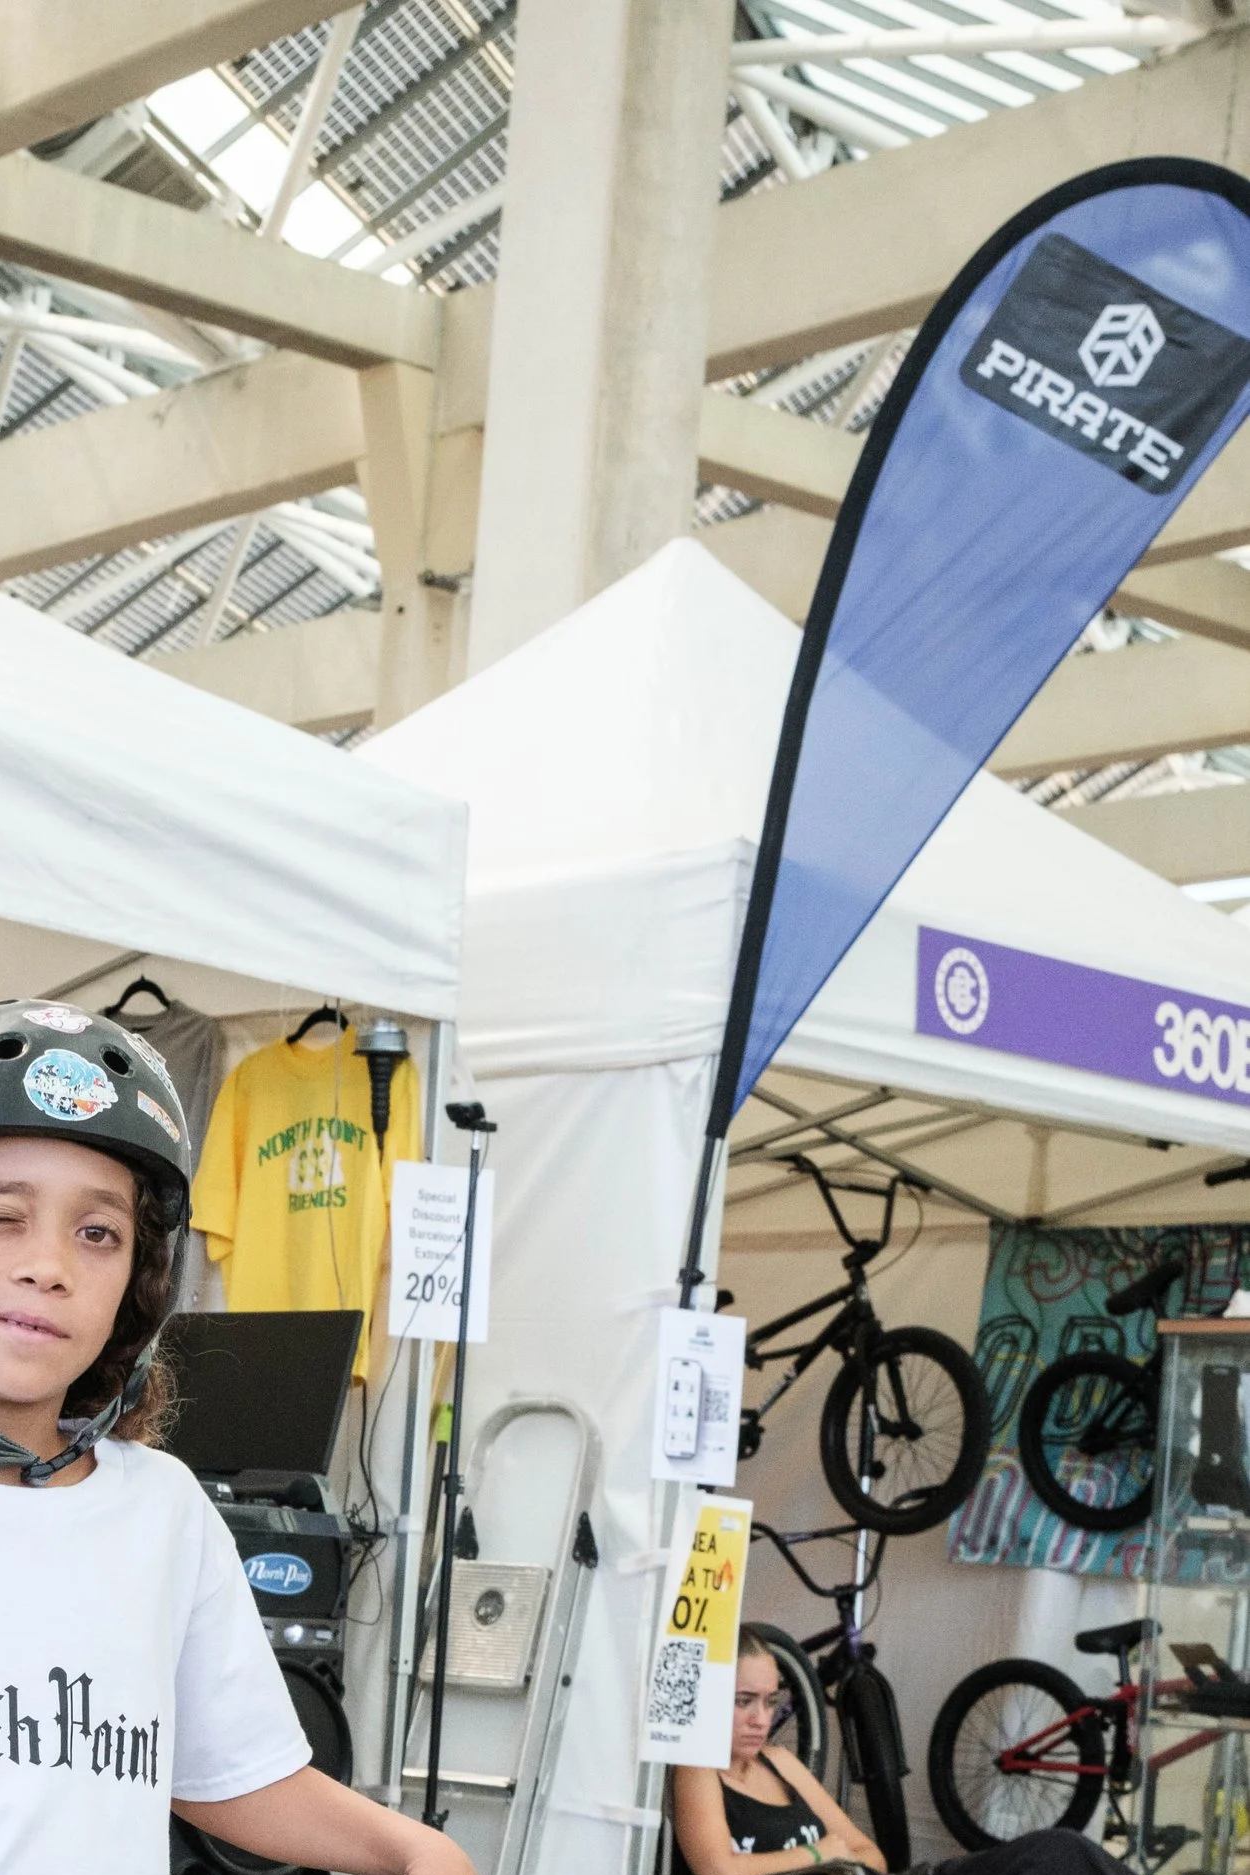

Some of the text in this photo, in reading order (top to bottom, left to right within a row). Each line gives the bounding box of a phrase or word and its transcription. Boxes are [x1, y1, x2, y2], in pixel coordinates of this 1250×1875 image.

[976, 338, 1185, 481] PIRATE
[418, 1188, 457, 1203] Special
[412, 1208, 462, 1224] Discount
[405, 1272, 462, 1307] 20%
[48, 1666, 160, 1789] Point
